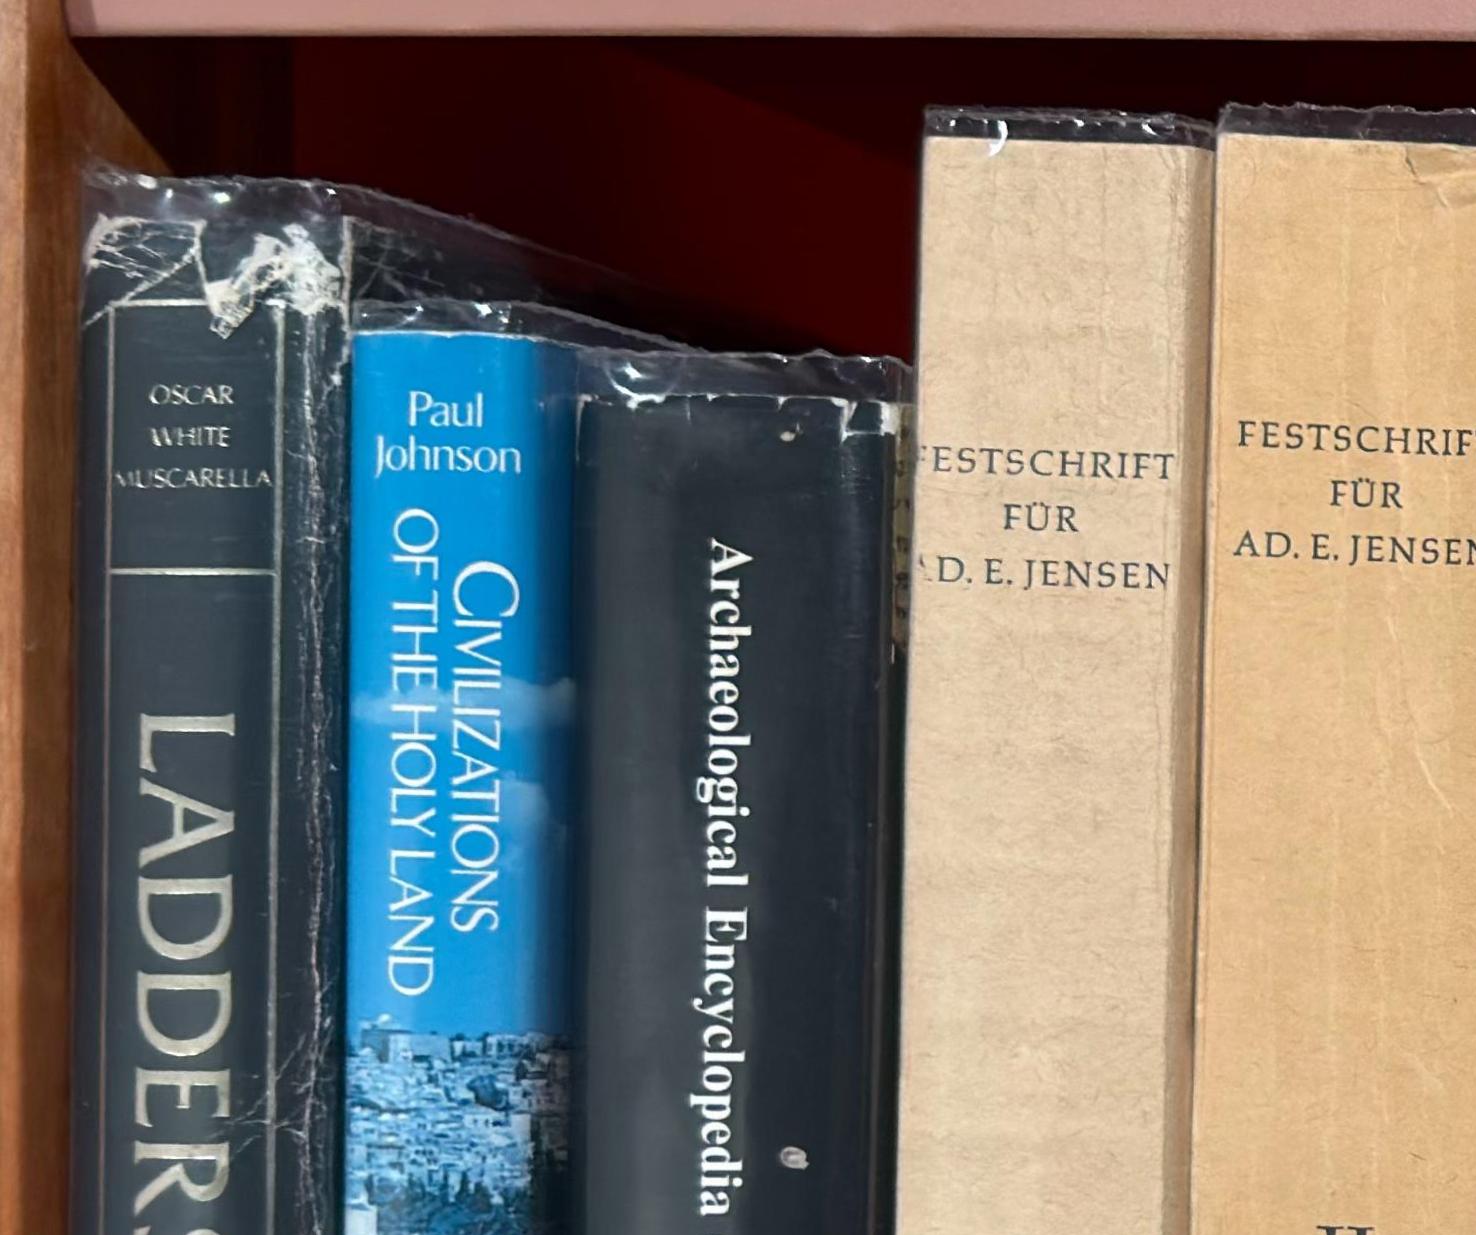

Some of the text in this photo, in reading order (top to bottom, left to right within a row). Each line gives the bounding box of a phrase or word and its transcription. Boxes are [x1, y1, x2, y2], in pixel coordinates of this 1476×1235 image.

[149, 384, 234, 405] OSCAR
[408, 392, 484, 428] Paul
[150, 426, 231, 447] WHITE
[375, 434, 521, 478] Johnson
[115, 468, 273, 488] MUSCARELLA
[1330, 478, 1402, 509] FÜR
[1004, 502, 1079, 532] FÜR
[1233, 530, 1299, 559] AD.
[1311, 533, 1338, 562] E.
[920, 555, 1170, 590] D. E. JENSEN
[695, 537, 755, 888] Archaeological
[388, 508, 440, 996] OF THE HOLY LAND
[689, 907, 748, 1218] Encyclopedia
